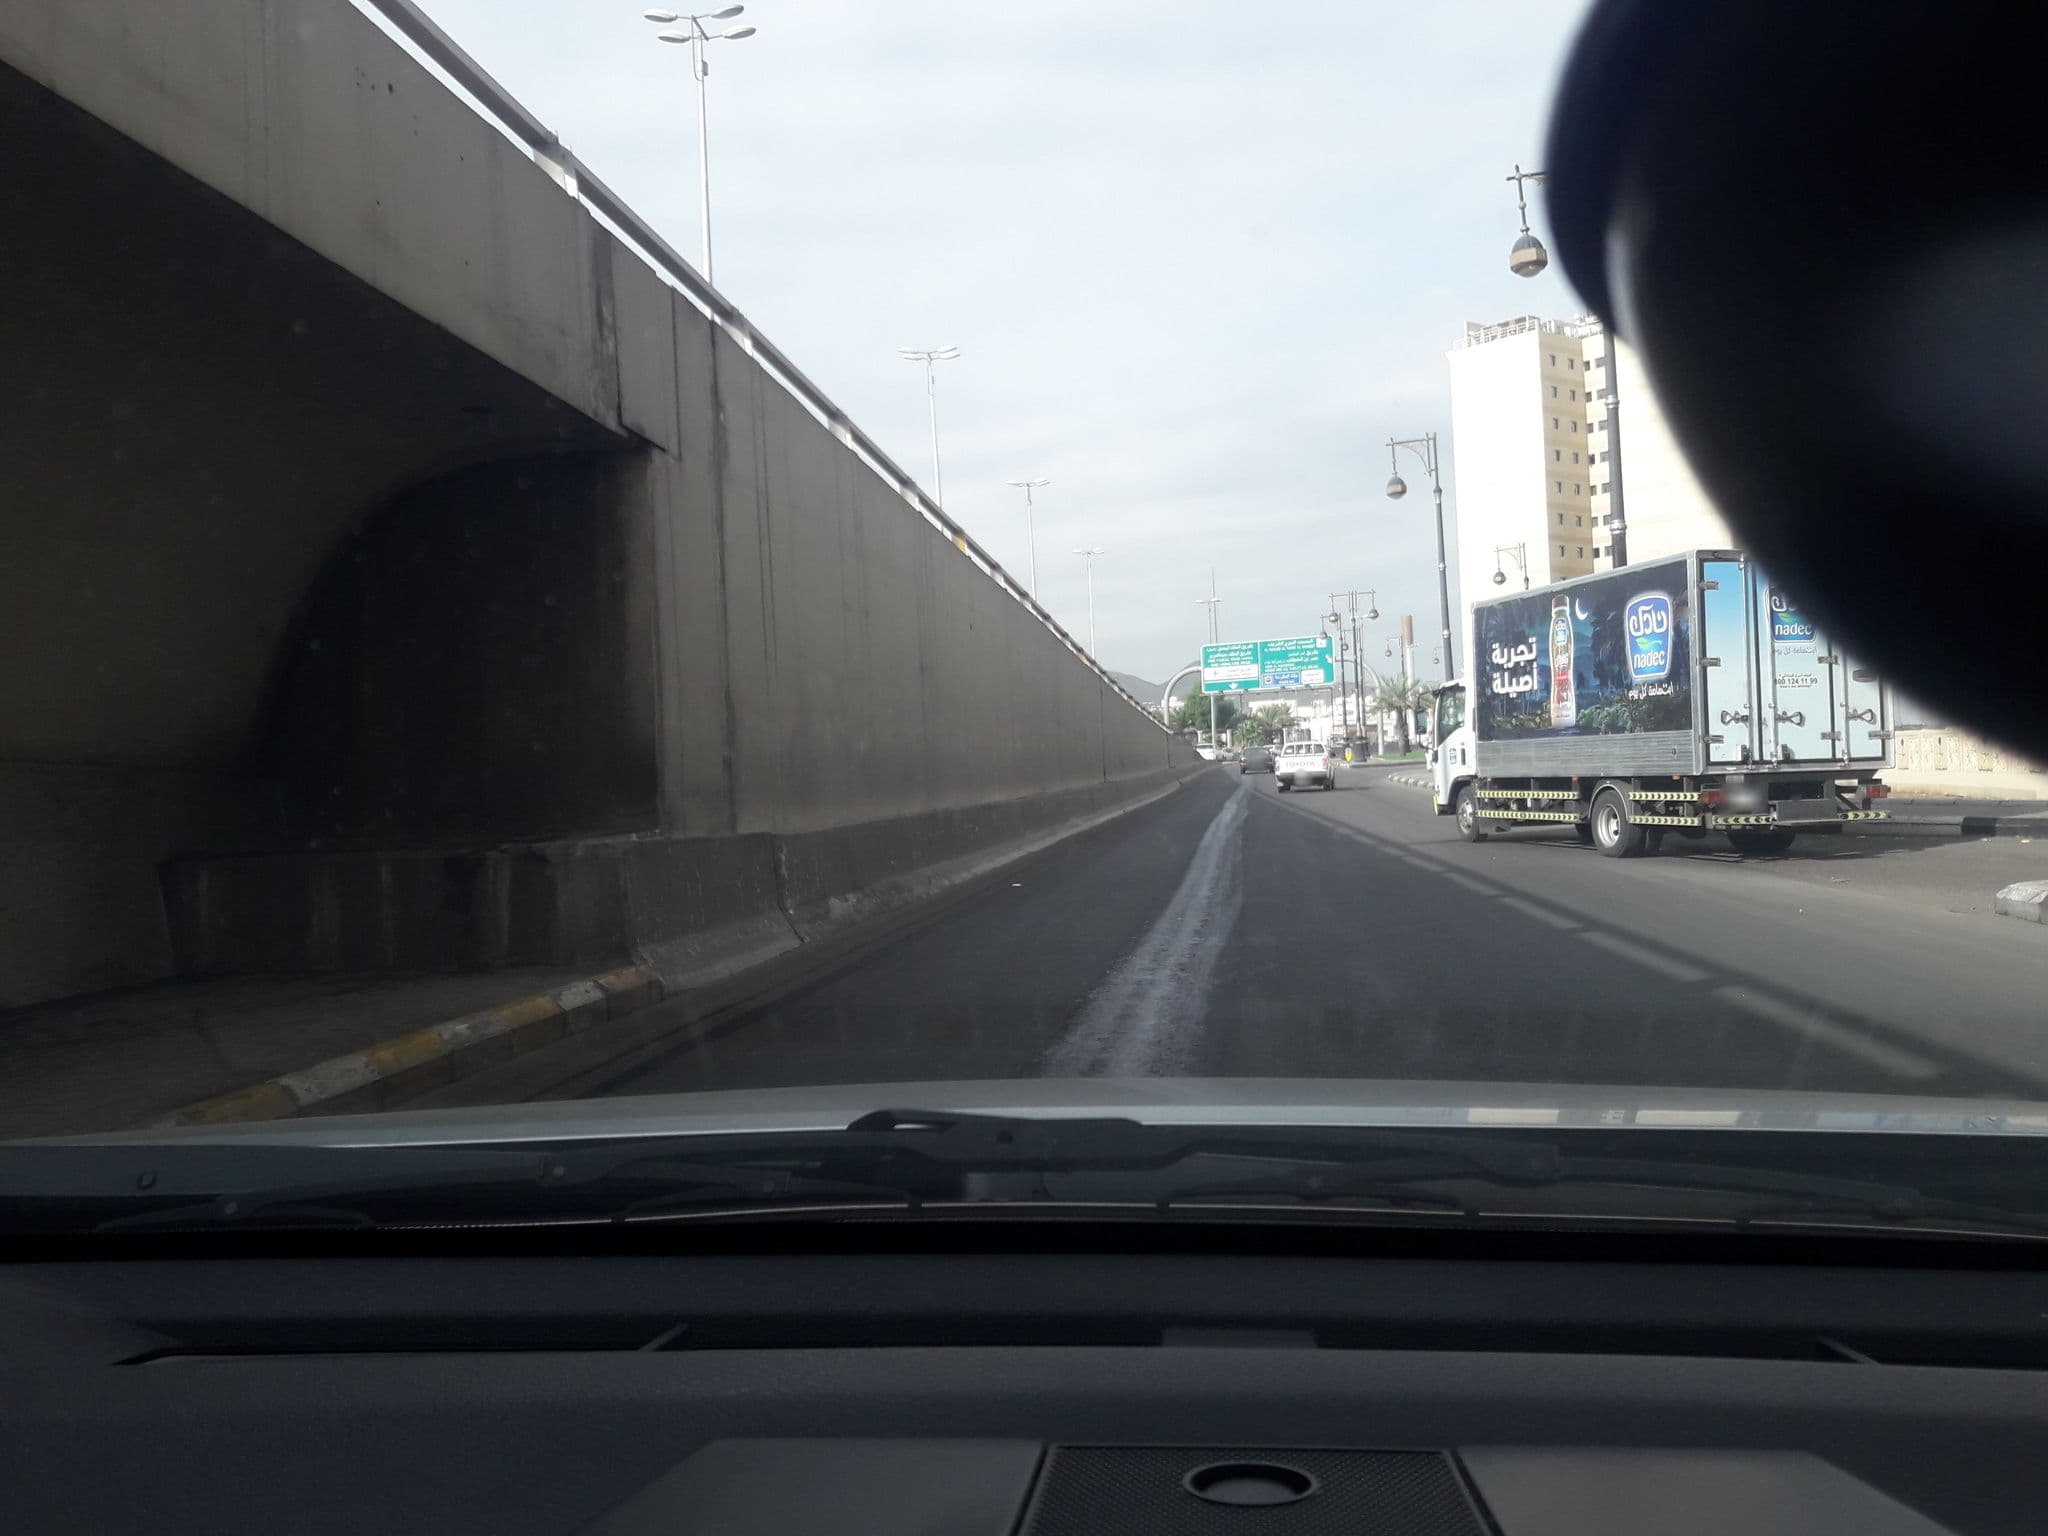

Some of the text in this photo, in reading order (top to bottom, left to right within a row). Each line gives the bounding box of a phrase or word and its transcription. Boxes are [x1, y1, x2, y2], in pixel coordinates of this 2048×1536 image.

[1629, 603, 1667, 637] نادك
[1774, 622, 1812, 636] nadec
[1491, 636, 1537, 669] تجربة
[1633, 649, 1665, 669] nadec
[1492, 661, 1537, 698] أصيلة
[1639, 683, 1647, 700] كل
